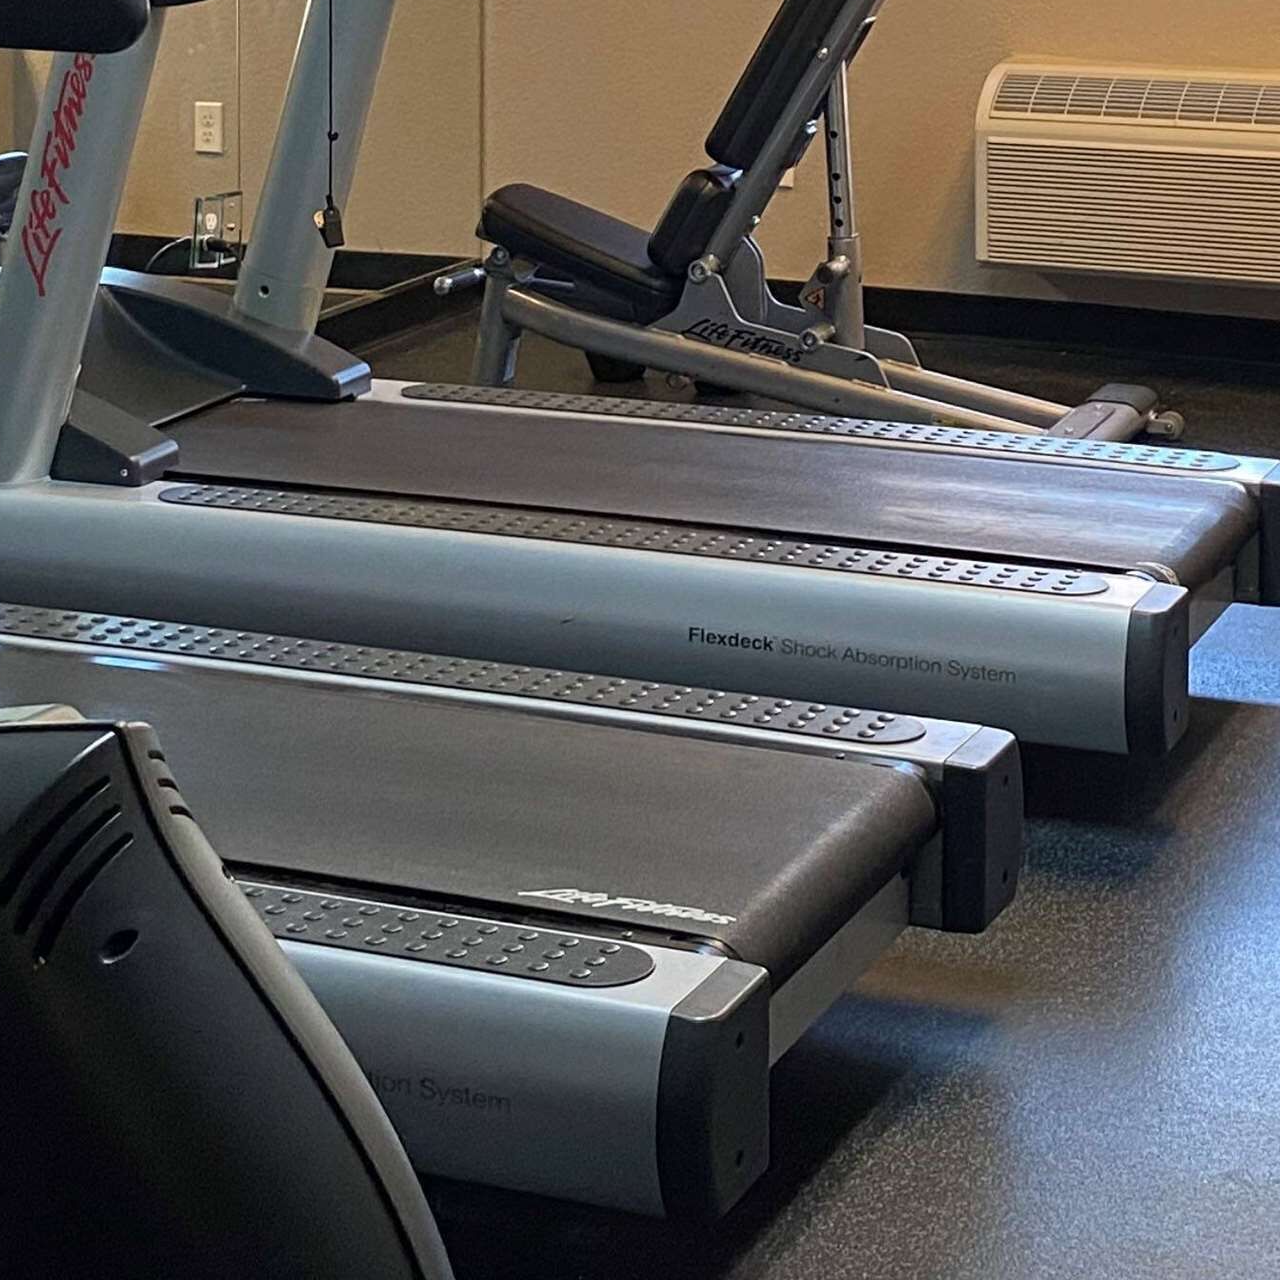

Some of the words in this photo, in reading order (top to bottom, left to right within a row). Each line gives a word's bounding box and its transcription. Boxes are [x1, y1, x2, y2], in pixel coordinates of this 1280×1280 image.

[687, 626, 774, 652] Flexdeck
[780, 637, 837, 660] Shock
[841, 646, 942, 676] Absorption
[947, 659, 1017, 684] System
[420, 1077, 511, 1113] System
